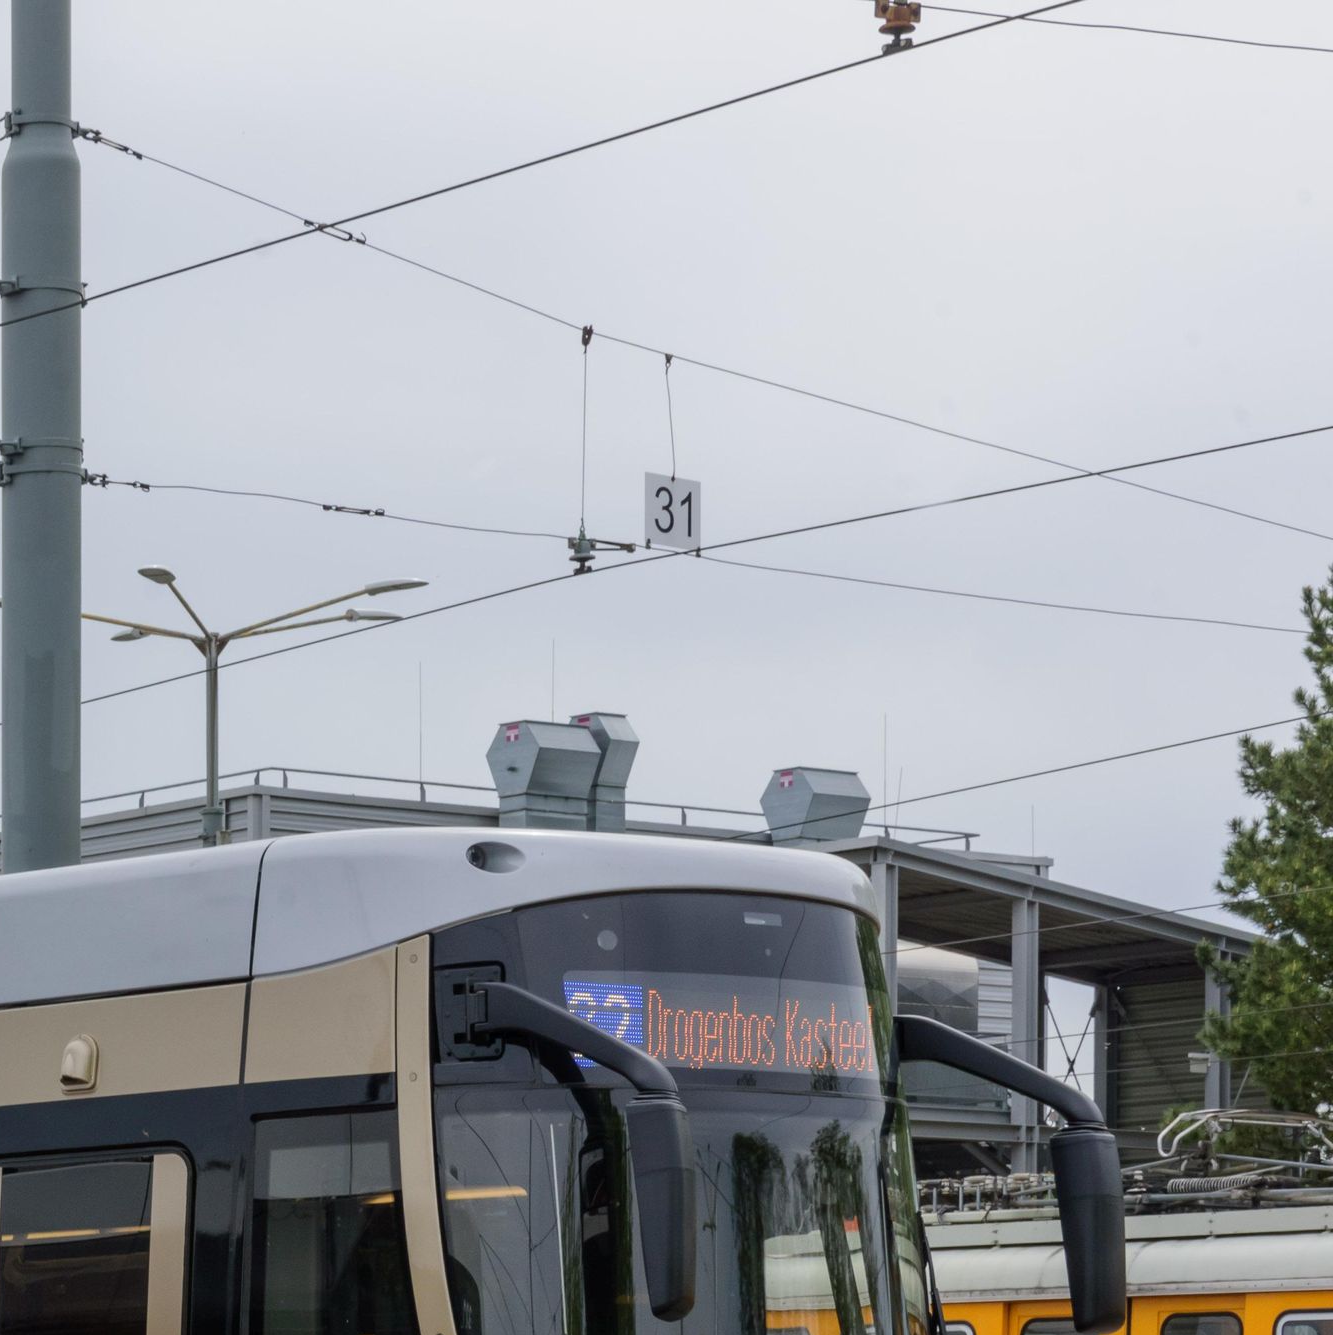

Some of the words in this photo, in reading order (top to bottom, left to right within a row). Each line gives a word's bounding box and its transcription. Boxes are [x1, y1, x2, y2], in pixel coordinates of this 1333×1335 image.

[654, 486, 693, 537] 31
[648, 989, 776, 1070] Drogenbos
[785, 999, 874, 1072] Kasteel
